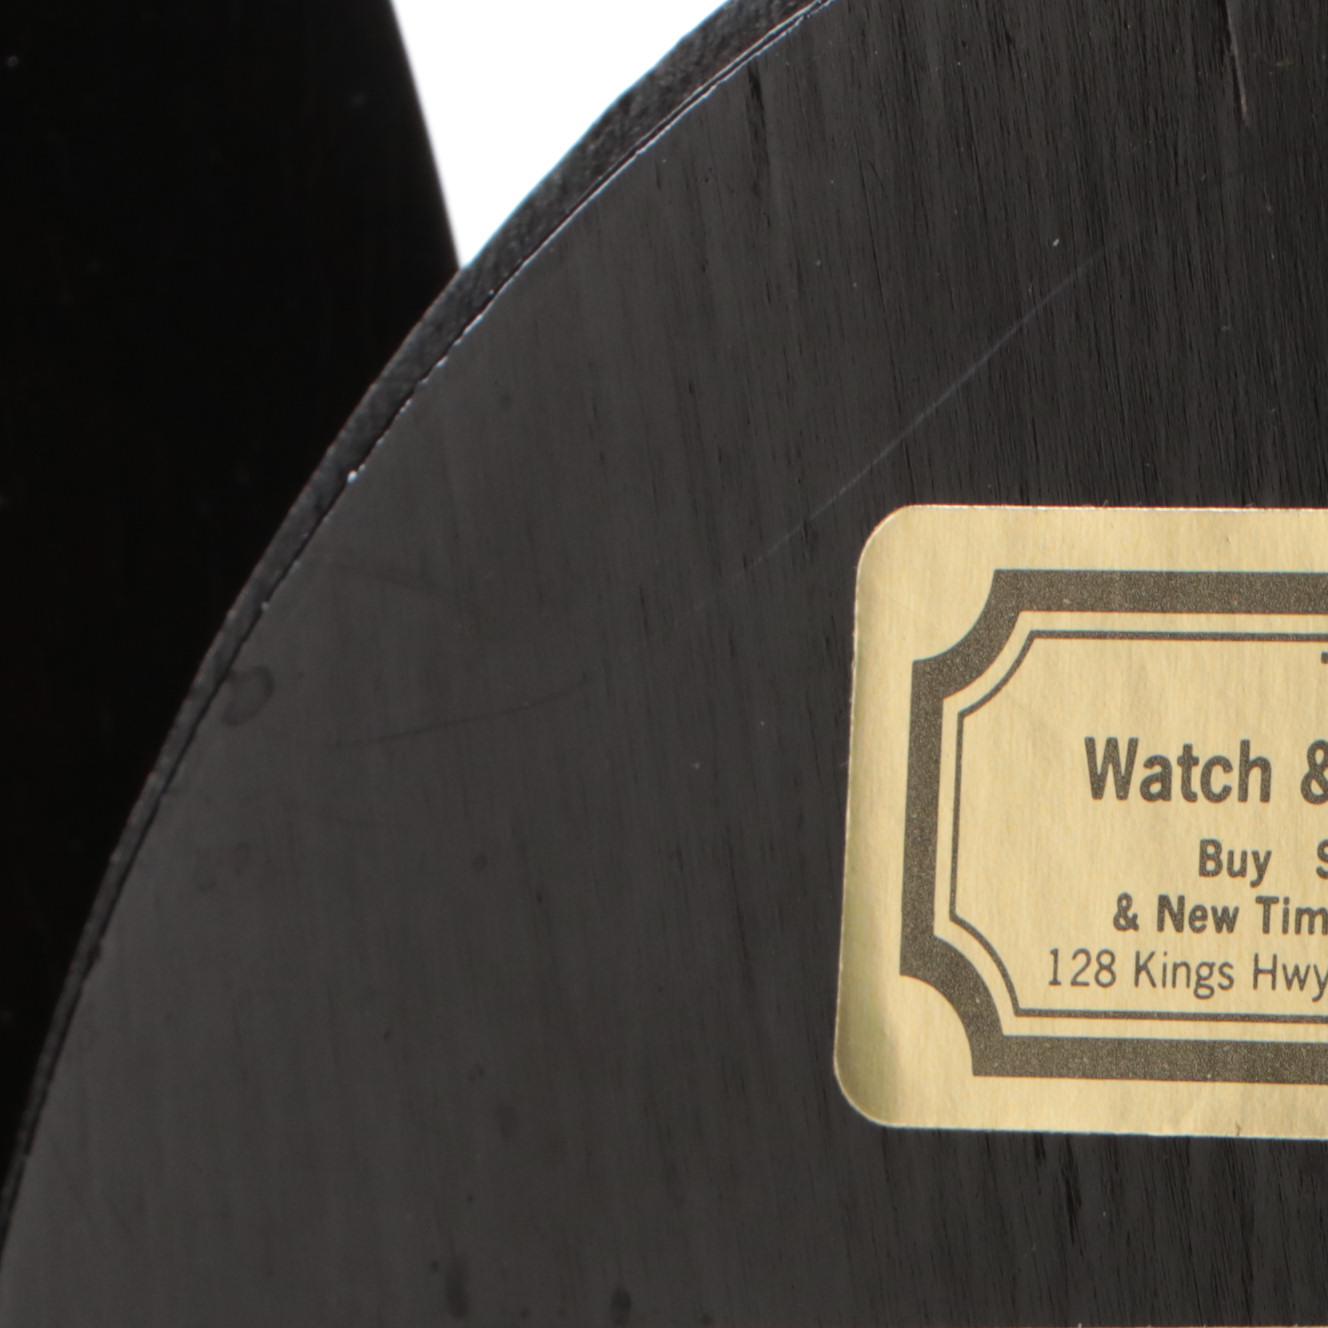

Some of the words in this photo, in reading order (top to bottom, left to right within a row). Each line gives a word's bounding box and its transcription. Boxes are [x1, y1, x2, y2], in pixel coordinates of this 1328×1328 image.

[1084, 736, 1272, 804] Watch
[1198, 838, 1272, 889] Buy
[1112, 893, 1140, 932] &
[1156, 893, 1240, 934] New
[1048, 948, 1117, 989] 128
[1133, 950, 1235, 1000] Kings
